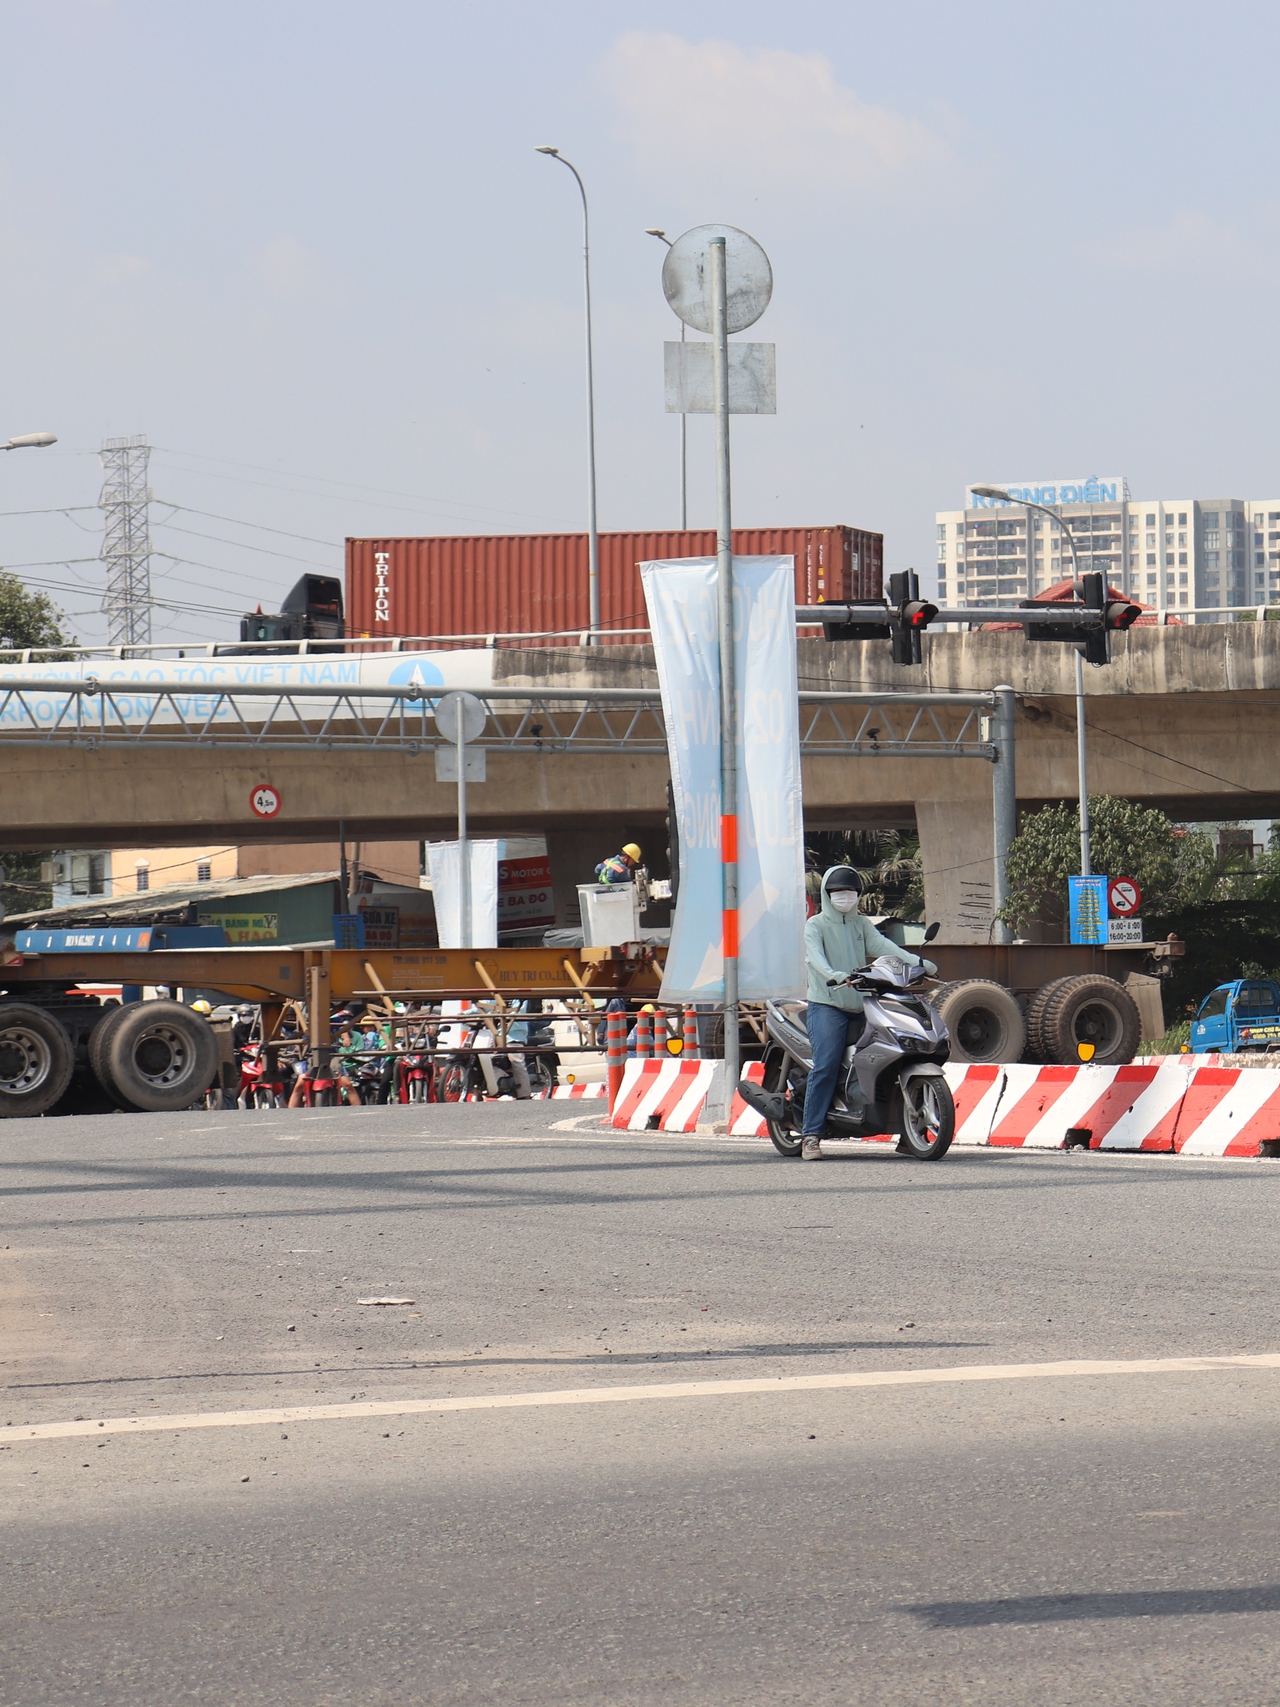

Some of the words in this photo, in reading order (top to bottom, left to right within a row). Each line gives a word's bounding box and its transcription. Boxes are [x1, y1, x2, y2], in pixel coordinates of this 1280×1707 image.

[374, 552, 390, 621] TRITON
[300, 663, 357, 685] NAM
[176, 695, 228, 717] VEC
[511, 868, 543, 878] MOTOR
[508, 896, 525, 906] BA
[500, 970, 519, 982] HUY
